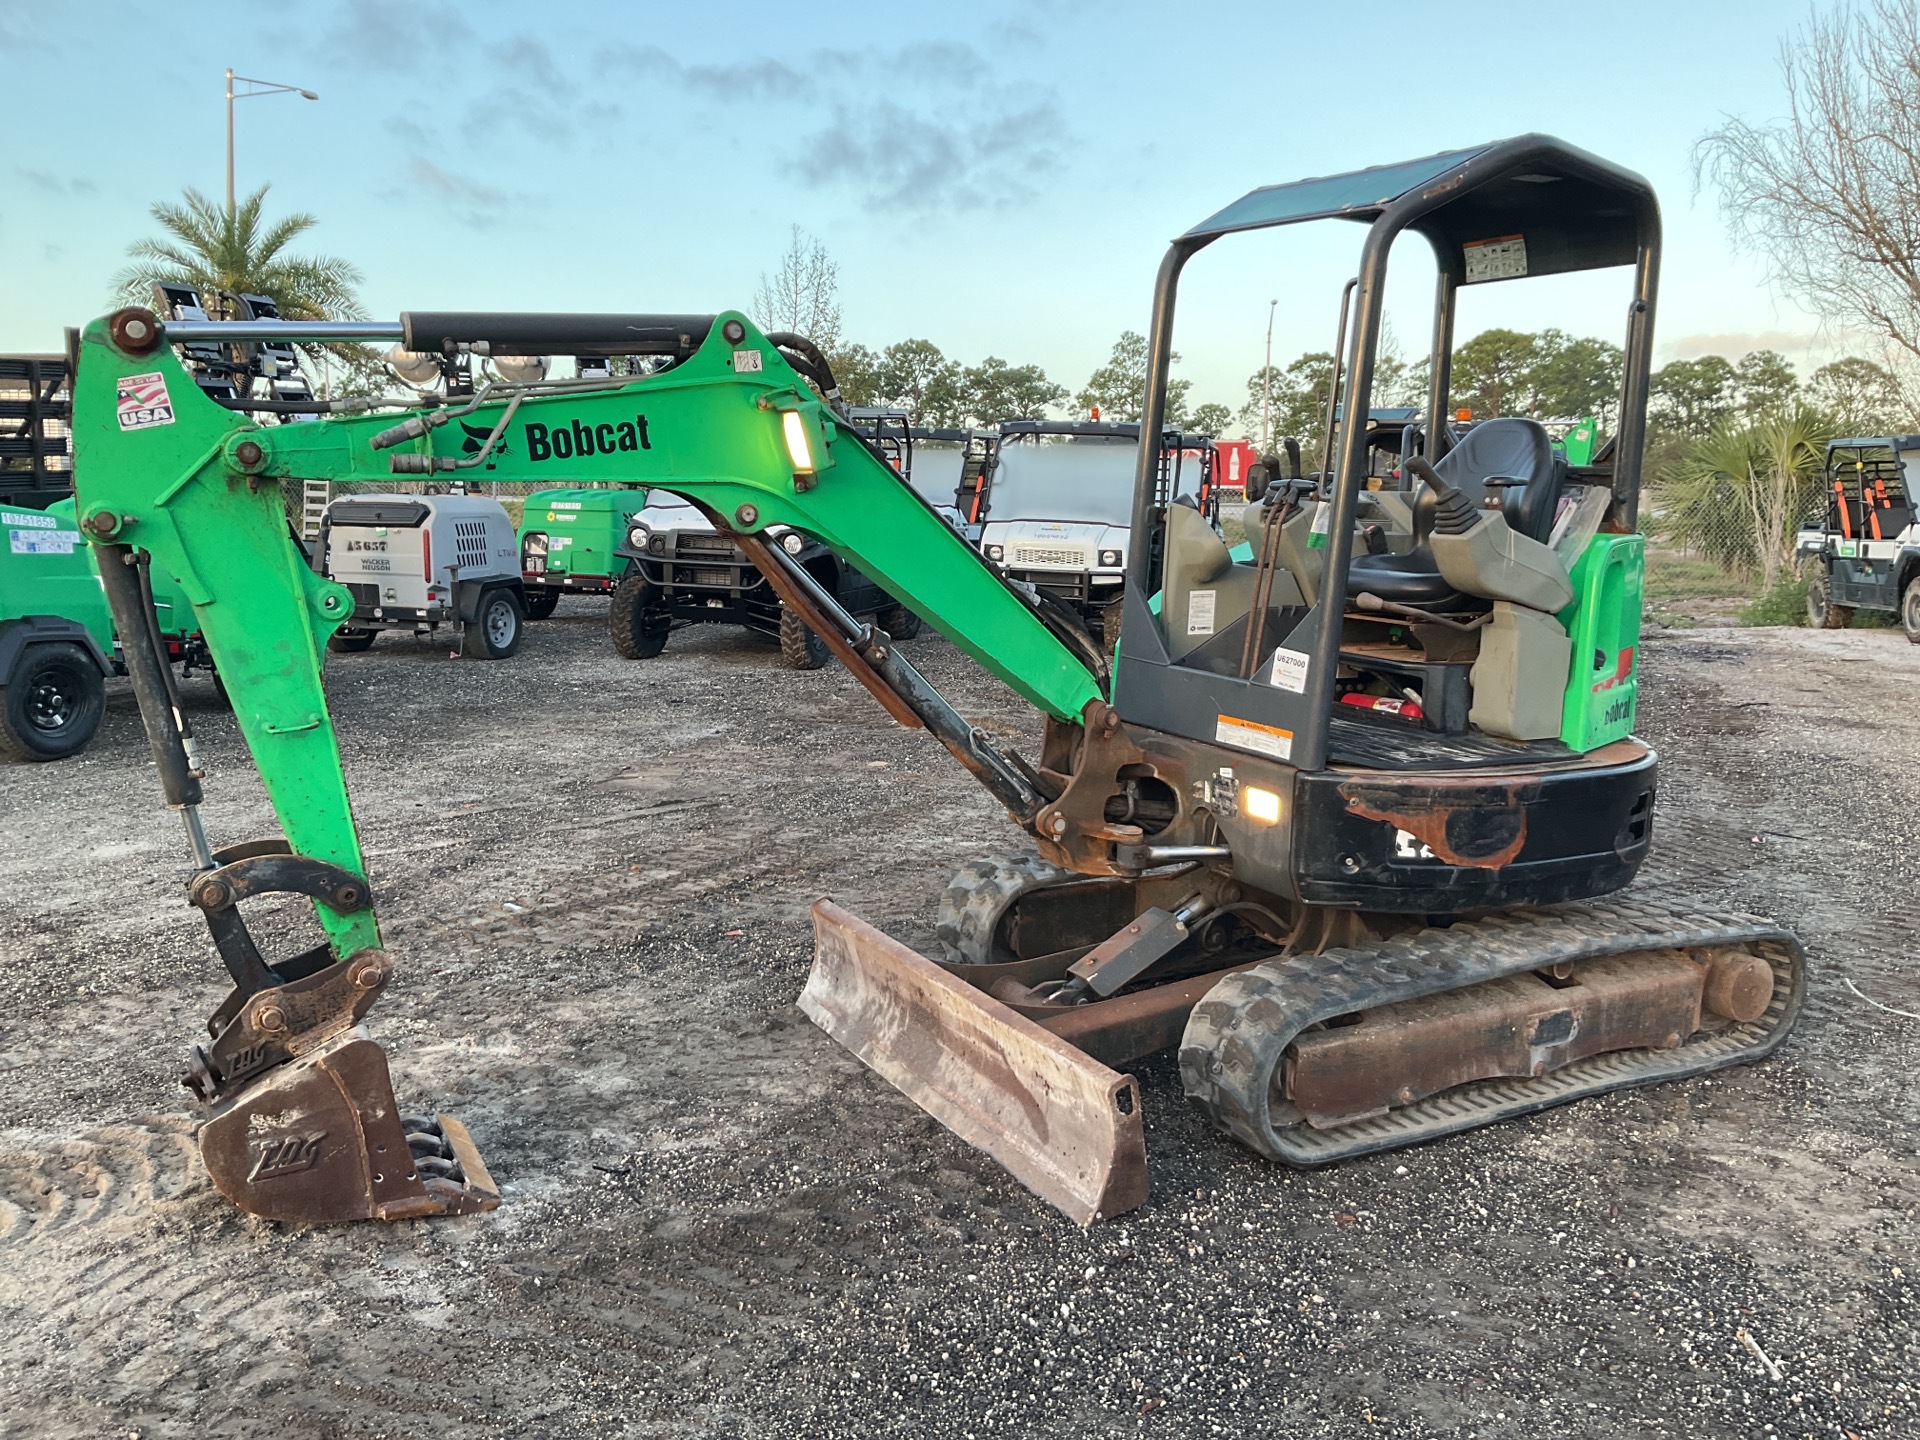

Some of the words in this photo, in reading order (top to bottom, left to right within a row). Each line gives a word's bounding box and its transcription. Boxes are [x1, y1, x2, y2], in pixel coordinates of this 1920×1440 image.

[121, 408, 170, 426] USA
[525, 414, 652, 462] Bobcat
[3, 513, 56, 528] 10751858
[347, 540, 387, 552] A5657
[1277, 654, 1306, 668] U627000
